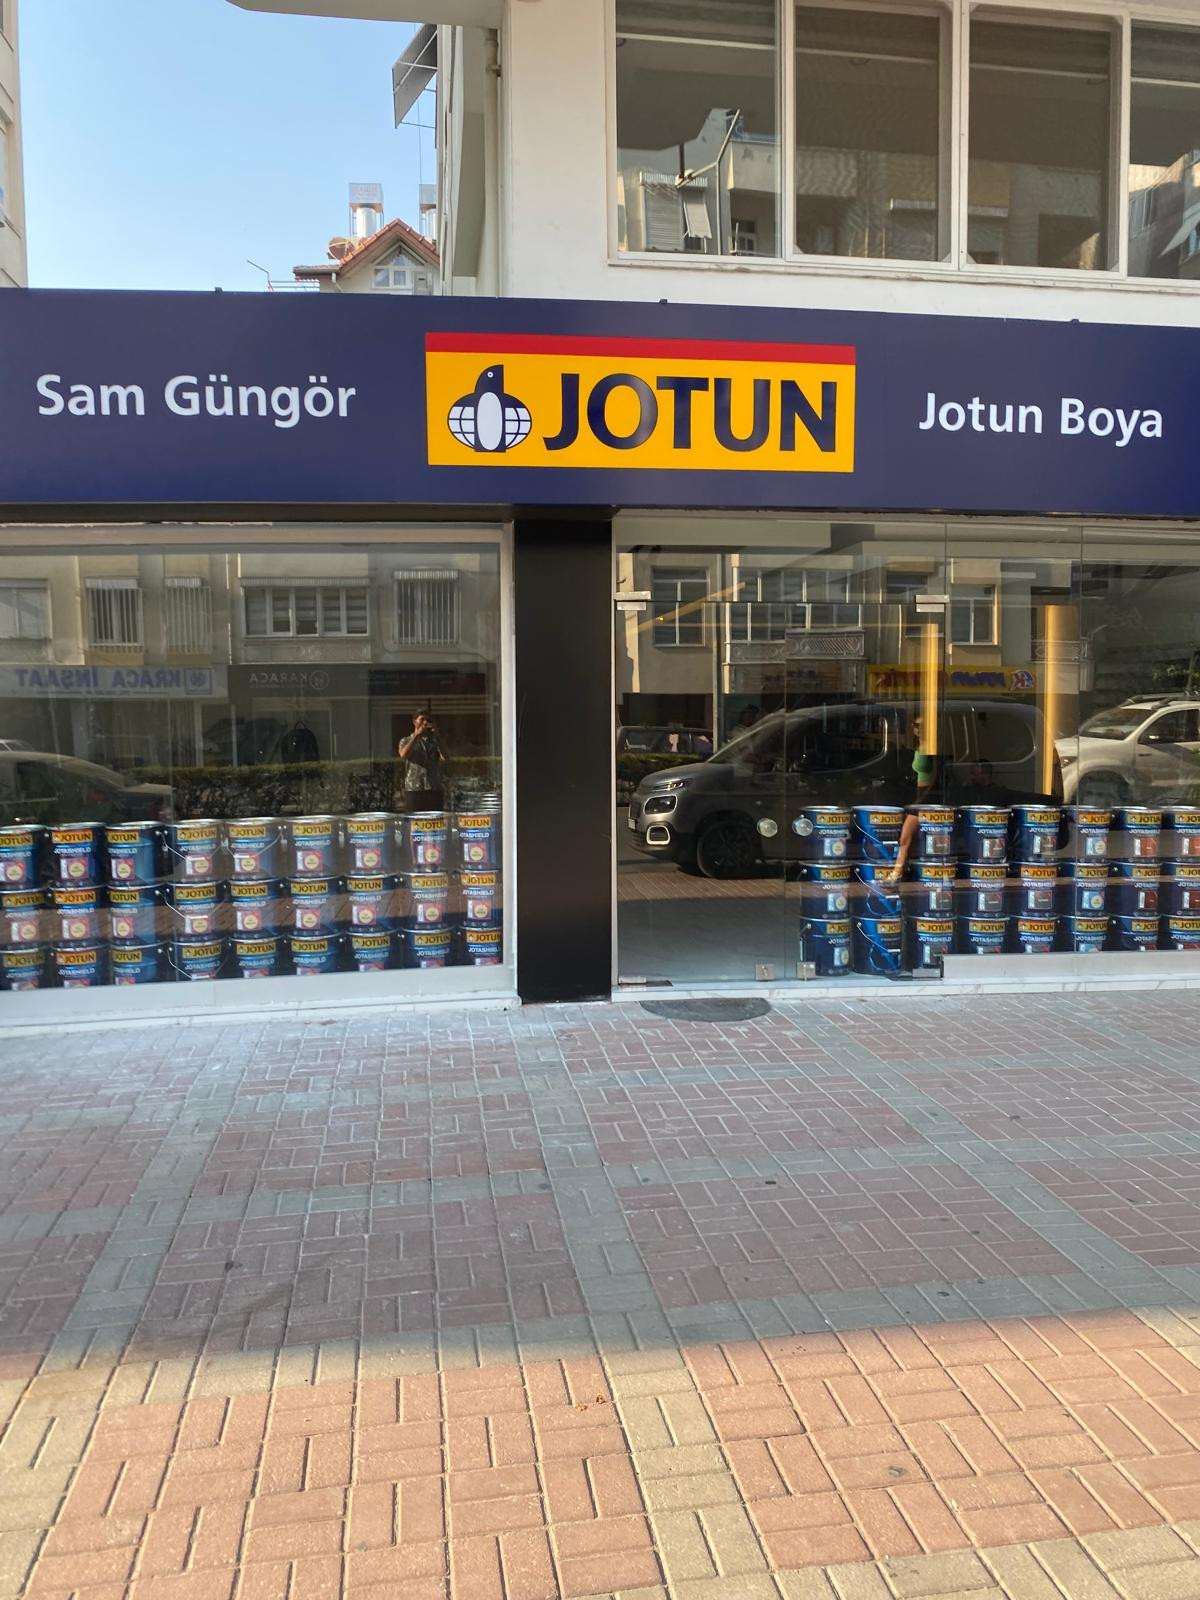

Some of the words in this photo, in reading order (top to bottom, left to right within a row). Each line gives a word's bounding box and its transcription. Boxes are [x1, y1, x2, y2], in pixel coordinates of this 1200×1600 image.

[36, 374, 145, 416] Sam
[164, 374, 356, 428] Güngör
[542, 372, 838, 453] JOTUN
[918, 392, 1043, 434] Jotun
[1060, 397, 1163, 447] Boya
[356, 823, 384, 832] JOTUN
[463, 819, 489, 827] JOTUN
[236, 827, 265, 836] JOTUN
[302, 825, 330, 834] JOTUN
[60, 832, 91, 841] JOTUN
[188, 830, 216, 839] JOTUN
[467, 876, 494, 884] JOTUN
[299, 884, 327, 893] JOTUN
[353, 881, 381, 889] JOTUN
[186, 888, 215, 898] JOTUN
[237, 886, 266, 895] JOTUN
[63, 893, 94, 903] JOTUN
[299, 942, 327, 951] JOTUN
[362, 938, 389, 947] JOTUN
[246, 944, 275, 954] JOTUN
[64, 953, 95, 963] JOTUN
